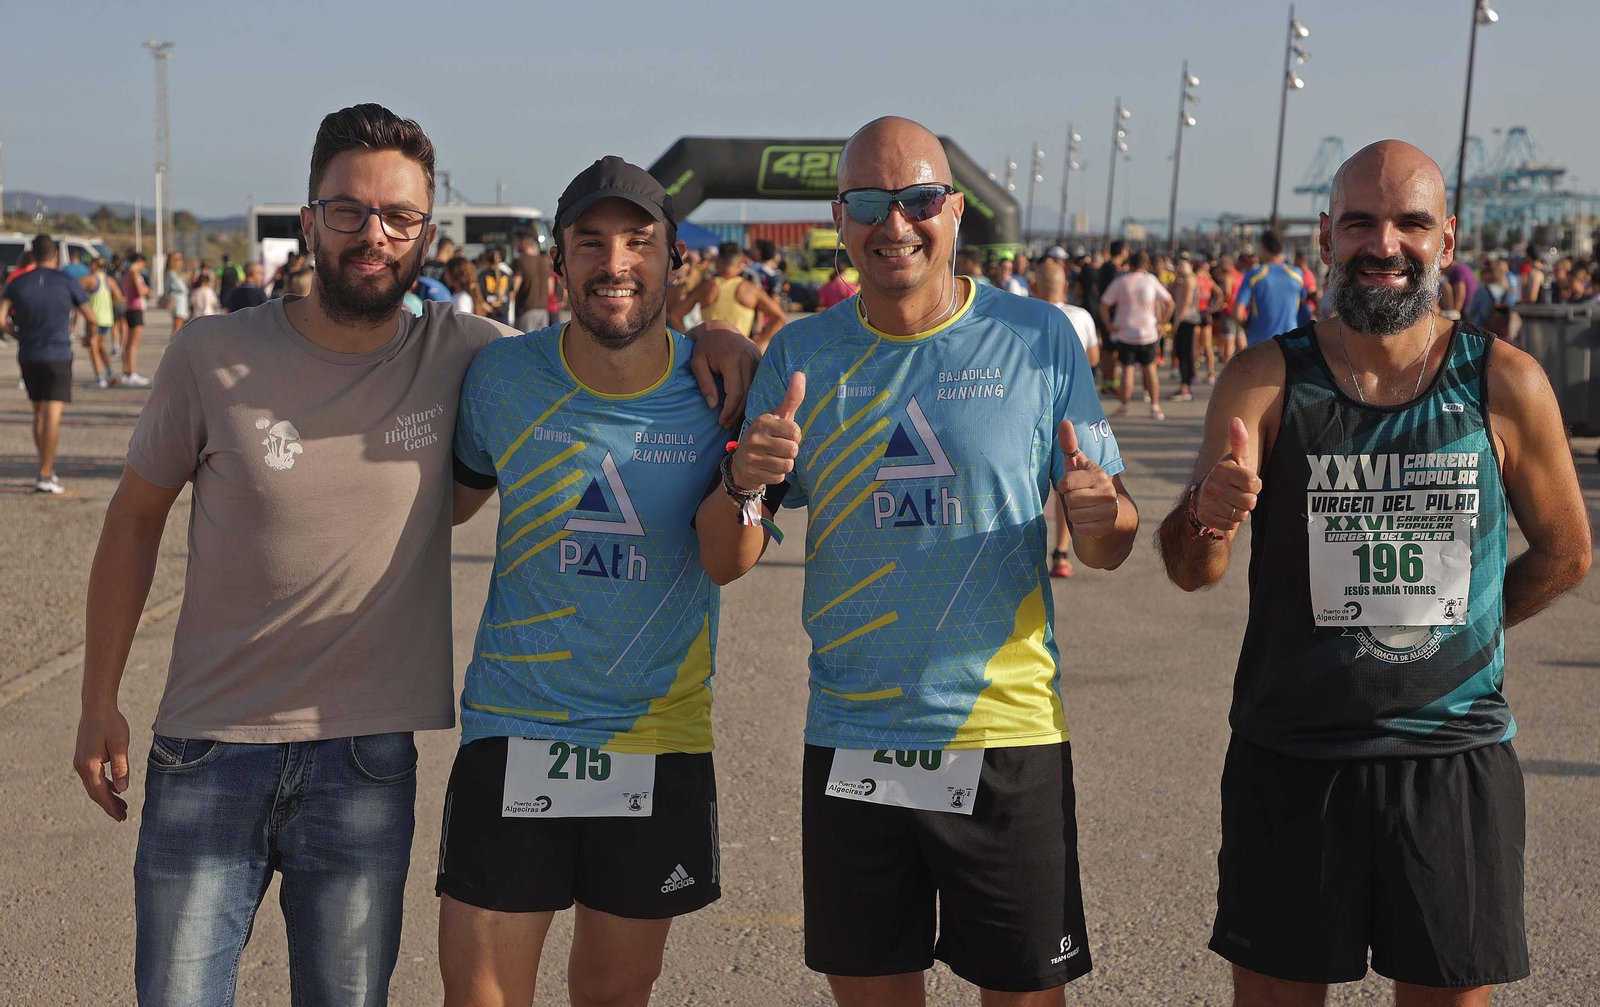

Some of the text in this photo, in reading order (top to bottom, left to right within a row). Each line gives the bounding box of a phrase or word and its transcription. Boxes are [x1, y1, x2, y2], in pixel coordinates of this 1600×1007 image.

[938, 367, 1002, 383] BAJADILLA
[937, 384, 1004, 401] RUNNING
[395, 403, 444, 429] Nature's
[384, 423, 432, 445] Hidden
[404, 432, 438, 452] Gems
[635, 431, 695, 445] BAJADILLA
[632, 449, 697, 464] RUNNING
[1403, 453, 1479, 469] CARRERA
[1306, 453, 1400, 490] XXVI
[1403, 470, 1479, 486] POPULAR
[1311, 493, 1477, 513] VIRGEN DEL PILAR
[1324, 515, 1394, 531] XXVI
[1396, 522, 1454, 530] POPULAR
[1327, 532, 1452, 541] VIRGEN DEL PILAR
[1352, 543, 1424, 584] 196
[1343, 584, 1436, 596] JESÚS MARÍA TORRES
[1316, 614, 1349, 622] Algeciras
[1409, 630, 1442, 660] ALGECIRAS
[548, 741, 612, 781] 215
[828, 784, 863, 796] Algeciras
[838, 780, 857, 788] Puerto
[504, 805, 539, 813] Algeciras
[660, 876, 696, 894] adidas
[1050, 955, 1067, 965] TEAM
